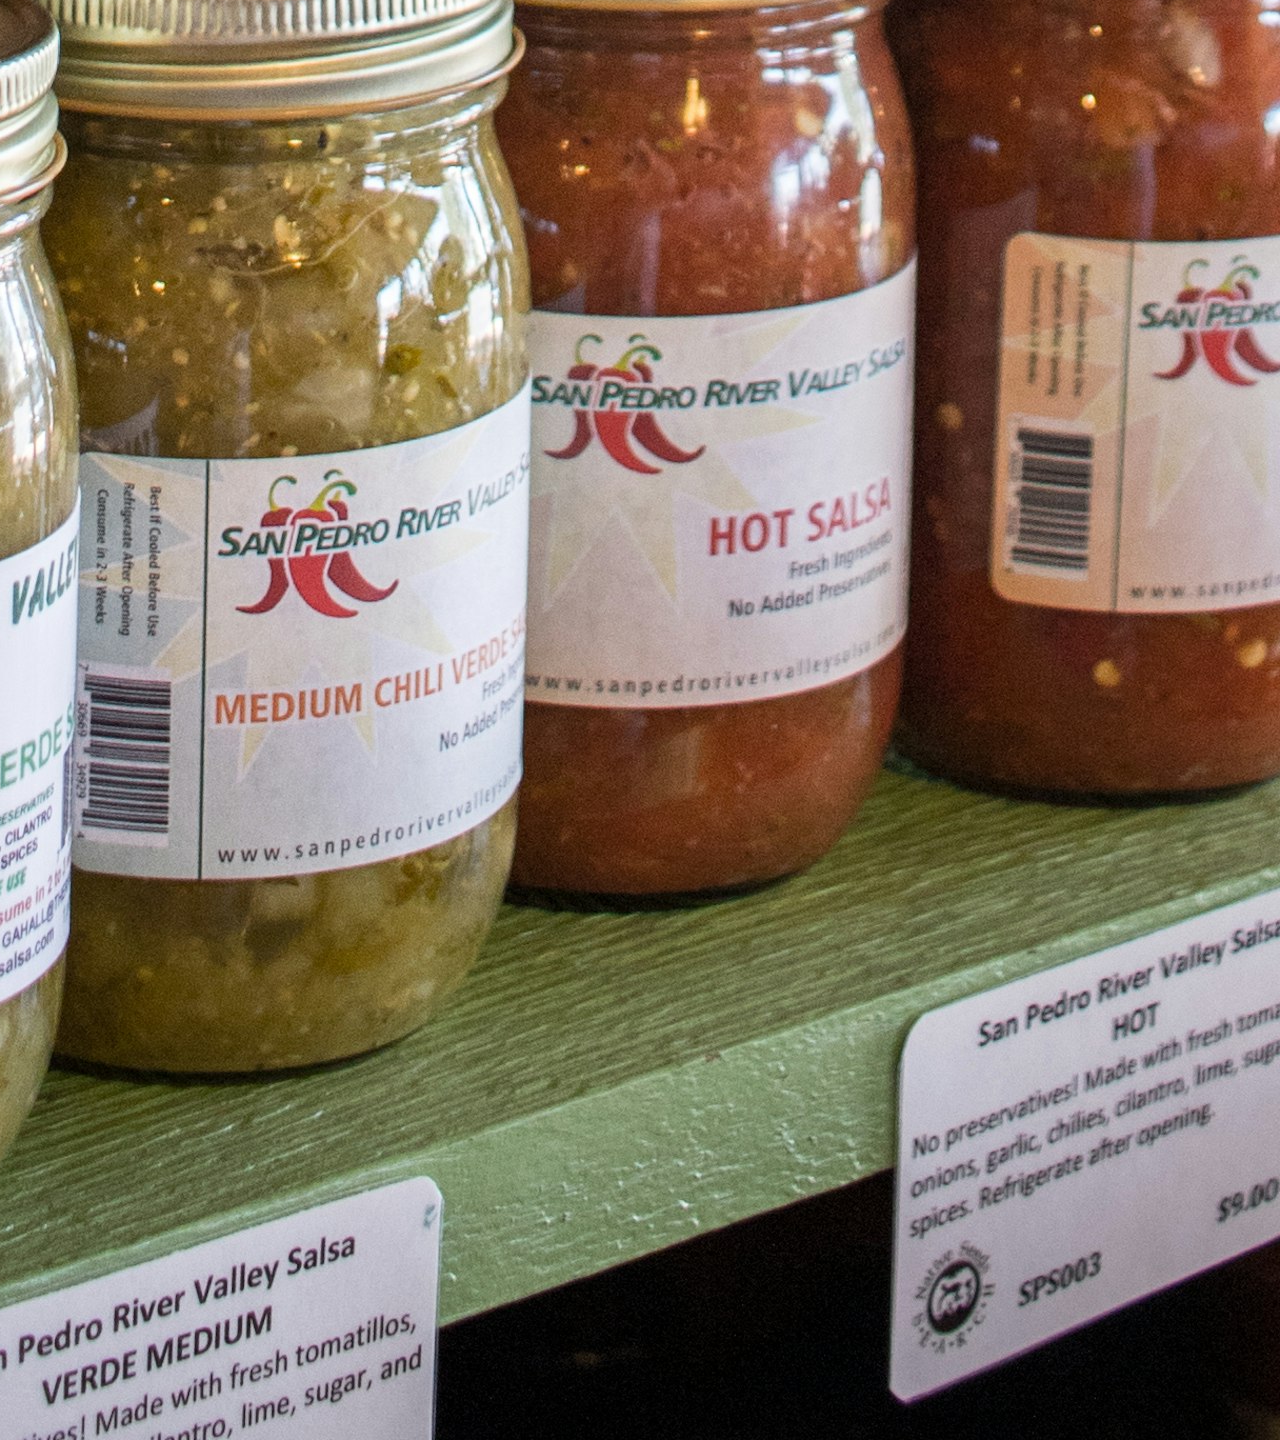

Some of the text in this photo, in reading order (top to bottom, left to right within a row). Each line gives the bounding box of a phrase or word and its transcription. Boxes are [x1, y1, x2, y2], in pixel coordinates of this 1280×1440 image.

[1139, 302, 1197, 330] SAN
[530, 361, 866, 409] SAN PEDRO RIVER VALLEY
[219, 501, 462, 557] SAN PEDRO RIVER
[708, 477, 891, 556] HOT SALSA
[789, 553, 829, 580] Fresh
[728, 589, 814, 618] No Added
[215, 635, 507, 725] MEDIUM CHILI VERDE
[439, 730, 458, 752] No
[0, 838, 39, 870] SPICES
[5, 806, 52, 846] CILANTRO
[977, 1014, 1019, 1049] San
[1025, 989, 1092, 1030] Pedro
[1098, 963, 1155, 1005] River
[1159, 938, 1228, 980] Valley
[1111, 1003, 1161, 1042] HOT
[912, 1131, 940, 1160] No
[945, 1081, 1080, 1151] preservatives!
[1085, 1059, 1138, 1093] Made
[1141, 1037, 1182, 1070] with
[1187, 1018, 1233, 1054] fresh
[911, 1158, 981, 1198] onions,
[986, 1135, 1042, 1175] garlic,
[1047, 1108, 1111, 1146] chilies,
[1114, 1078, 1190, 1120] cilantro,
[1193, 1059, 1239, 1089] lime,
[909, 1103, 1217, 1240] spices. Refrigerate after opening.
[18, 1315, 103, 1363] Pedro
[113, 1285, 186, 1332] River
[194, 1259, 280, 1310] Valley
[287, 1234, 357, 1277] Salsa
[1017, 1251, 1104, 1309] SPS003
[42, 1305, 275, 1407] VERDE MEDIUM
[95, 1311, 418, 1438] Made with fresh tomatillos,
[241, 1348, 422, 1429] lime, sugar, and
